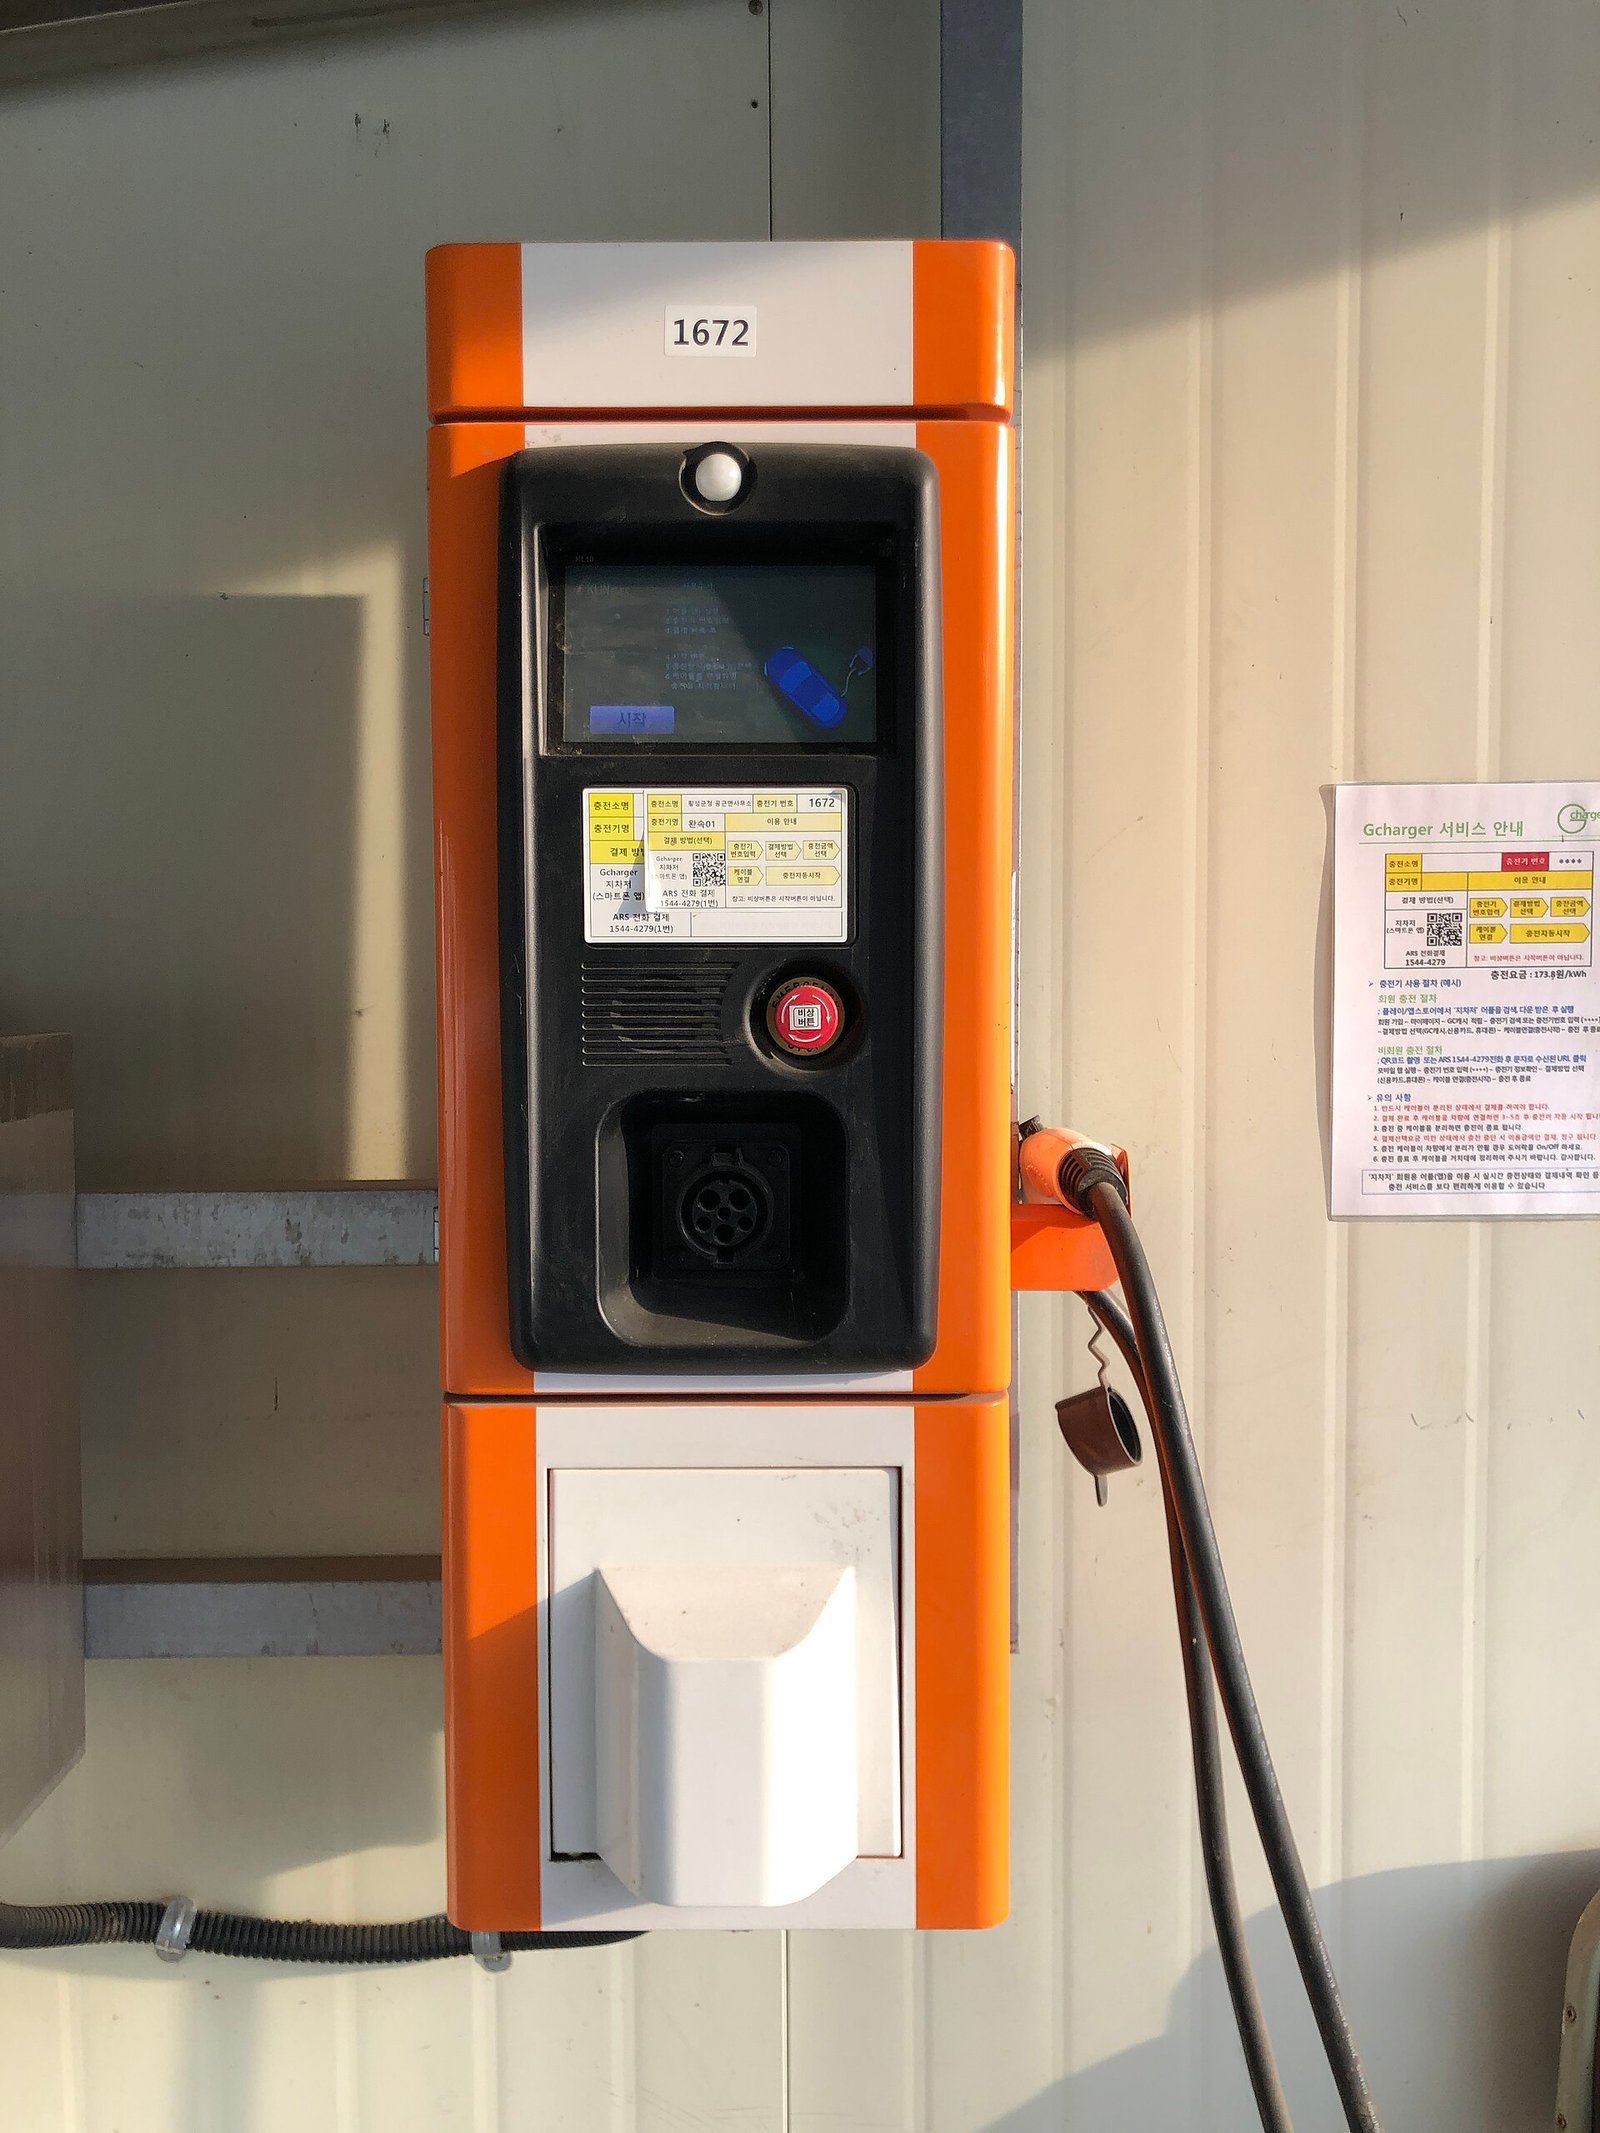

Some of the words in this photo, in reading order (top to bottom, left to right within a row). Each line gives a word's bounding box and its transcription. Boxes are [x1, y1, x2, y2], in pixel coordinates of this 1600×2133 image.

[674, 318, 748, 346] 1672
[618, 712, 646, 727] 시작
[594, 801, 629, 811] 충전소명
[651, 800, 678, 808] 충전소명
[756, 800, 777, 808] 충전기
[780, 800, 794, 808] 번호
[809, 798, 835, 808] 1672
[651, 818, 678, 826] 충전기명
[688, 820, 716, 829] 완속01
[767, 818, 780, 826] 이용
[784, 818, 797, 826] 안내
[594, 824, 630, 834] 충전기명
[1363, 822, 1433, 838] Gcharger
[1439, 821, 1486, 837] 서비스
[1493, 820, 1522, 836] 안내
[664, 837, 678, 846] 결제
[680, 836, 712, 845] 방법(선택)
[808, 842, 834, 850] 충전금액
[610, 847, 628, 857] 결제
[814, 850, 827, 858] 선택
[1389, 860, 1418, 868] 충전소명
[1506, 858, 1528, 866] 충전기
[1531, 858, 1545, 866] 번호
[600, 868, 638, 878] Gcharger
[734, 868, 752, 876] 케이블
[783, 872, 820, 880] 충전자동시작
[737, 876, 750, 884] 연결
[1389, 878, 1418, 886] 충전기명
[1514, 877, 1528, 885] 이용
[1532, 876, 1546, 884] 안내
[606, 880, 632, 889] 지차저
[593, 892, 630, 901] (스마트폰
[634, 892, 645, 901] 앱)
[681, 890, 696, 898] 전화
[700, 890, 716, 898] 결제
[660, 900, 718, 908] 1544-4279(1번)
[1402, 896, 1416, 904] 결제
[1419, 896, 1454, 904] 방법(선택)
[1476, 900, 1496, 908] 충전기
[1513, 900, 1540, 908] 결제방법
[1556, 900, 1583, 908] 충전금액
[1473, 908, 1500, 916] 번호입력
[1520, 908, 1533, 916] 선택
[612, 913, 630, 921] ARS
[633, 913, 649, 922] 전화
[653, 912, 670, 922] 결제
[610, 925, 674, 934] 1544-4279(1번)
[1476, 926, 1496, 934] 케이블
[1526, 930, 1570, 938] 충전자동시작
[1490, 970, 1527, 979] 충전요금
[1379, 979, 1402, 988] 충전기
[1404, 979, 1420, 987] 사용
[1422, 979, 1437, 987] 절차
[1378, 994, 1395, 1003] 회원
[1399, 994, 1416, 1003] 충전
[1420, 993, 1439, 1002] 절차
[798, 1008, 814, 1018] 비상
[798, 1018, 815, 1027] 버튼
[1378, 1046, 1402, 1055] 비회원
[1405, 1046, 1422, 1055] 충전
[1424, 1045, 1442, 1054] 절차
[1376, 1093, 1391, 1101] 유의
[1395, 1093, 1411, 1101] 사항
